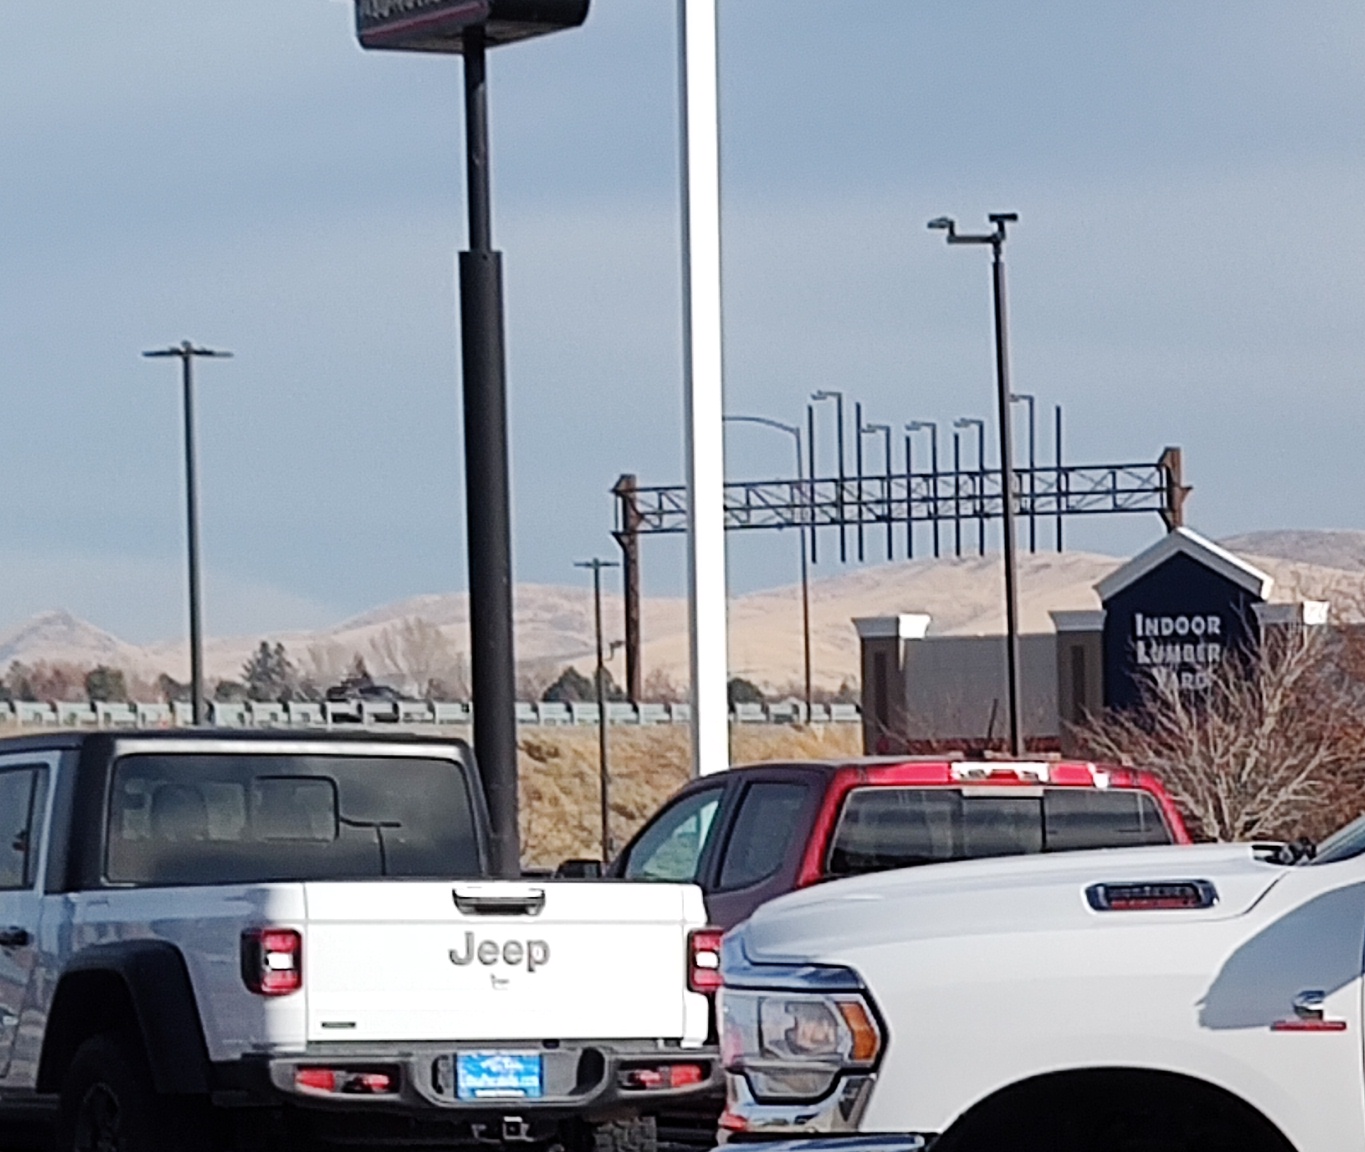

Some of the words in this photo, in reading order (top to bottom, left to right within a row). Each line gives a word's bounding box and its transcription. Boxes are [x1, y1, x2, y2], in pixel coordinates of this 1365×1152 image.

[1135, 613, 1221, 636] INDOOR
[1136, 640, 1221, 664] LUMBER
[448, 931, 550, 973] Jeep
